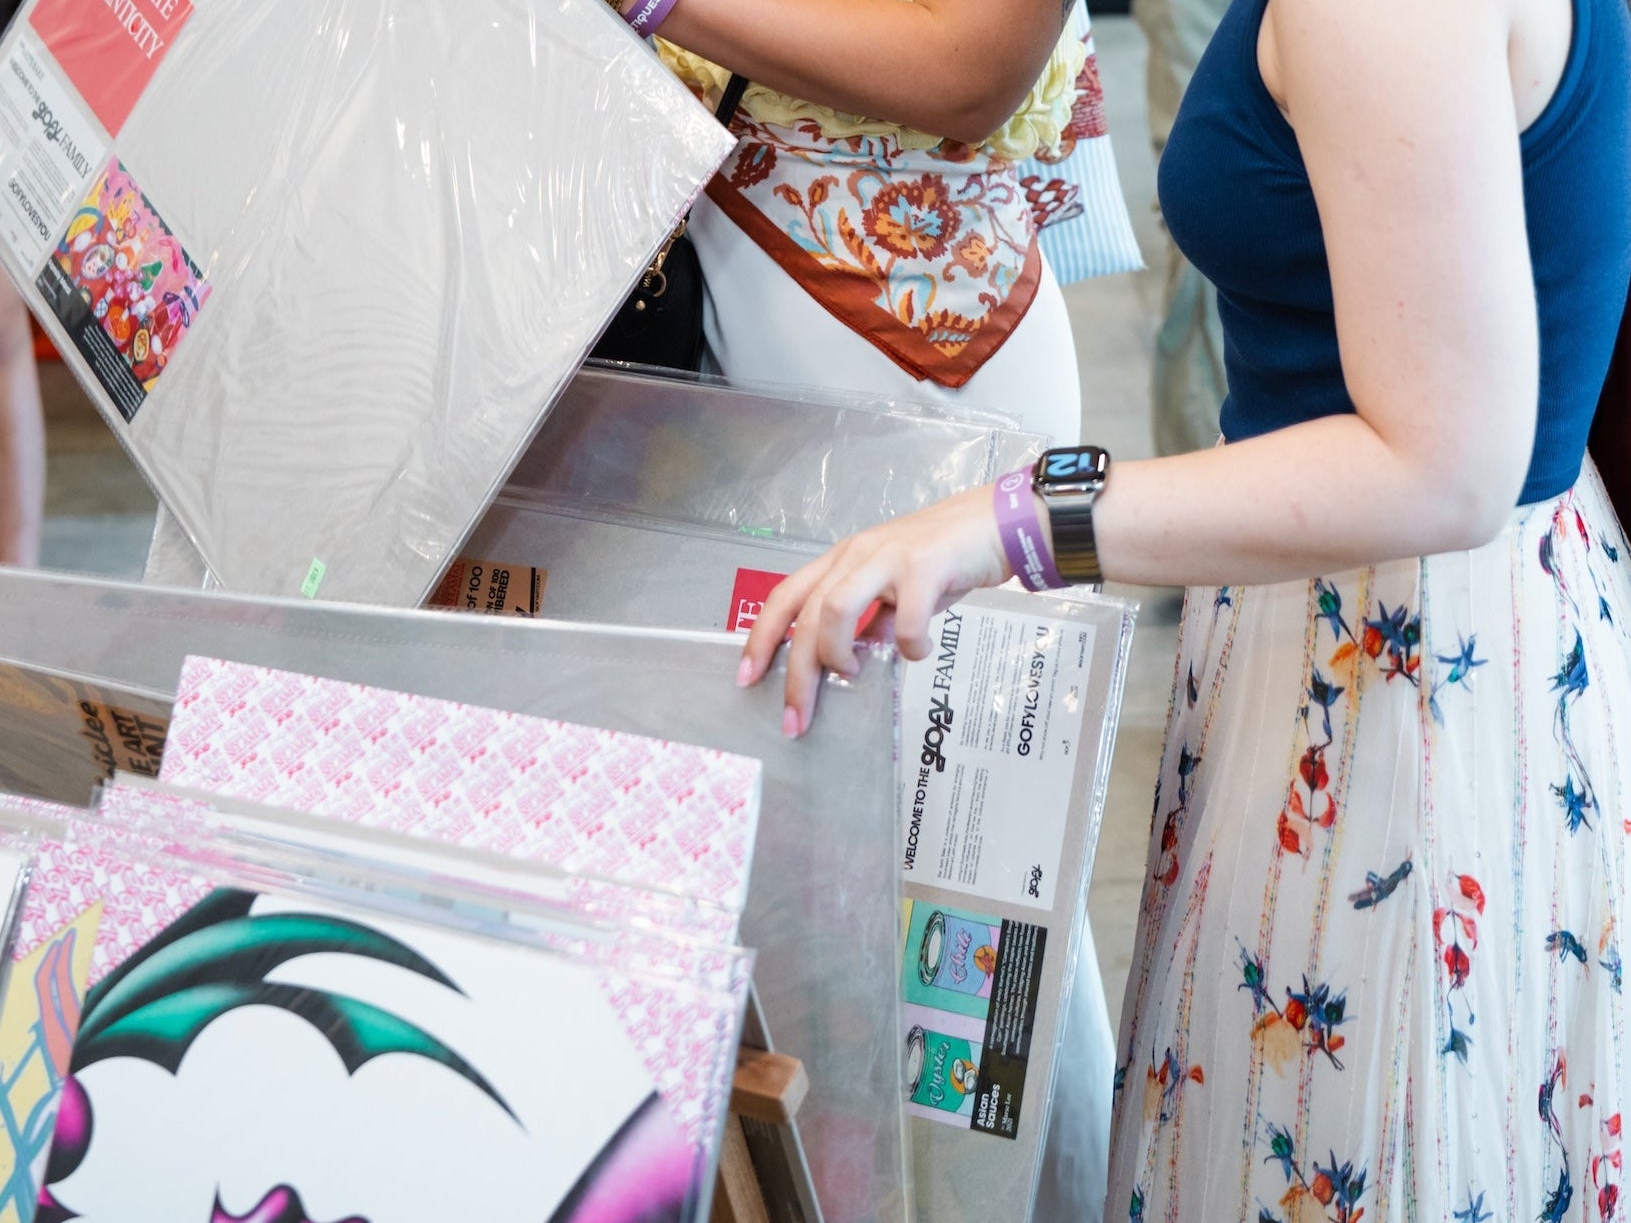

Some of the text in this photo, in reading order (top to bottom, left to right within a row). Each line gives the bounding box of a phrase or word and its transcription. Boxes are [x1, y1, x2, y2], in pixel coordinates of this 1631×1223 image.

[59, 133, 93, 180] FAMILY
[469, 566, 483, 591] 100
[488, 585, 497, 599] OF
[491, 568, 501, 583] 100
[111, 711, 143, 756] ART
[902, 608, 963, 871] WELCOME TO THE gofy FAMILY
[1027, 863, 1043, 897] gofy
[928, 1040, 951, 1106] Oyster
[976, 1092, 989, 1126] Asian
[985, 1083, 1000, 1129] Sauces
